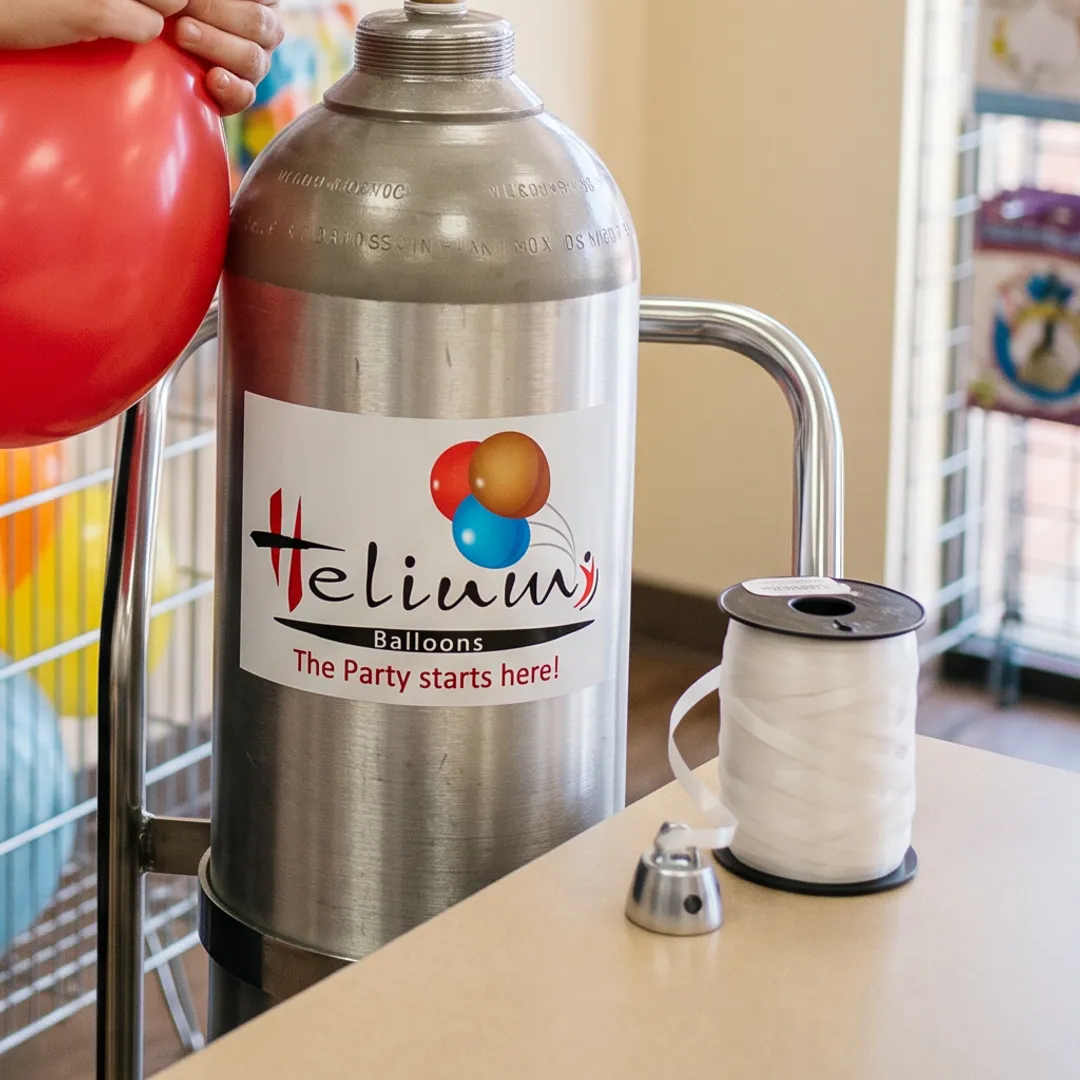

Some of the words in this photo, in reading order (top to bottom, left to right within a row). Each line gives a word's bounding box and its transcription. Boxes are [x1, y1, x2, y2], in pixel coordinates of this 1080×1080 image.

[250, 487, 578, 613] Helium
[373, 630, 484, 652] Balloons
[293, 648, 335, 679] The
[344, 658, 411, 694] Party
[419, 667, 492, 690] starts
[501, 655, 560, 687] here!
